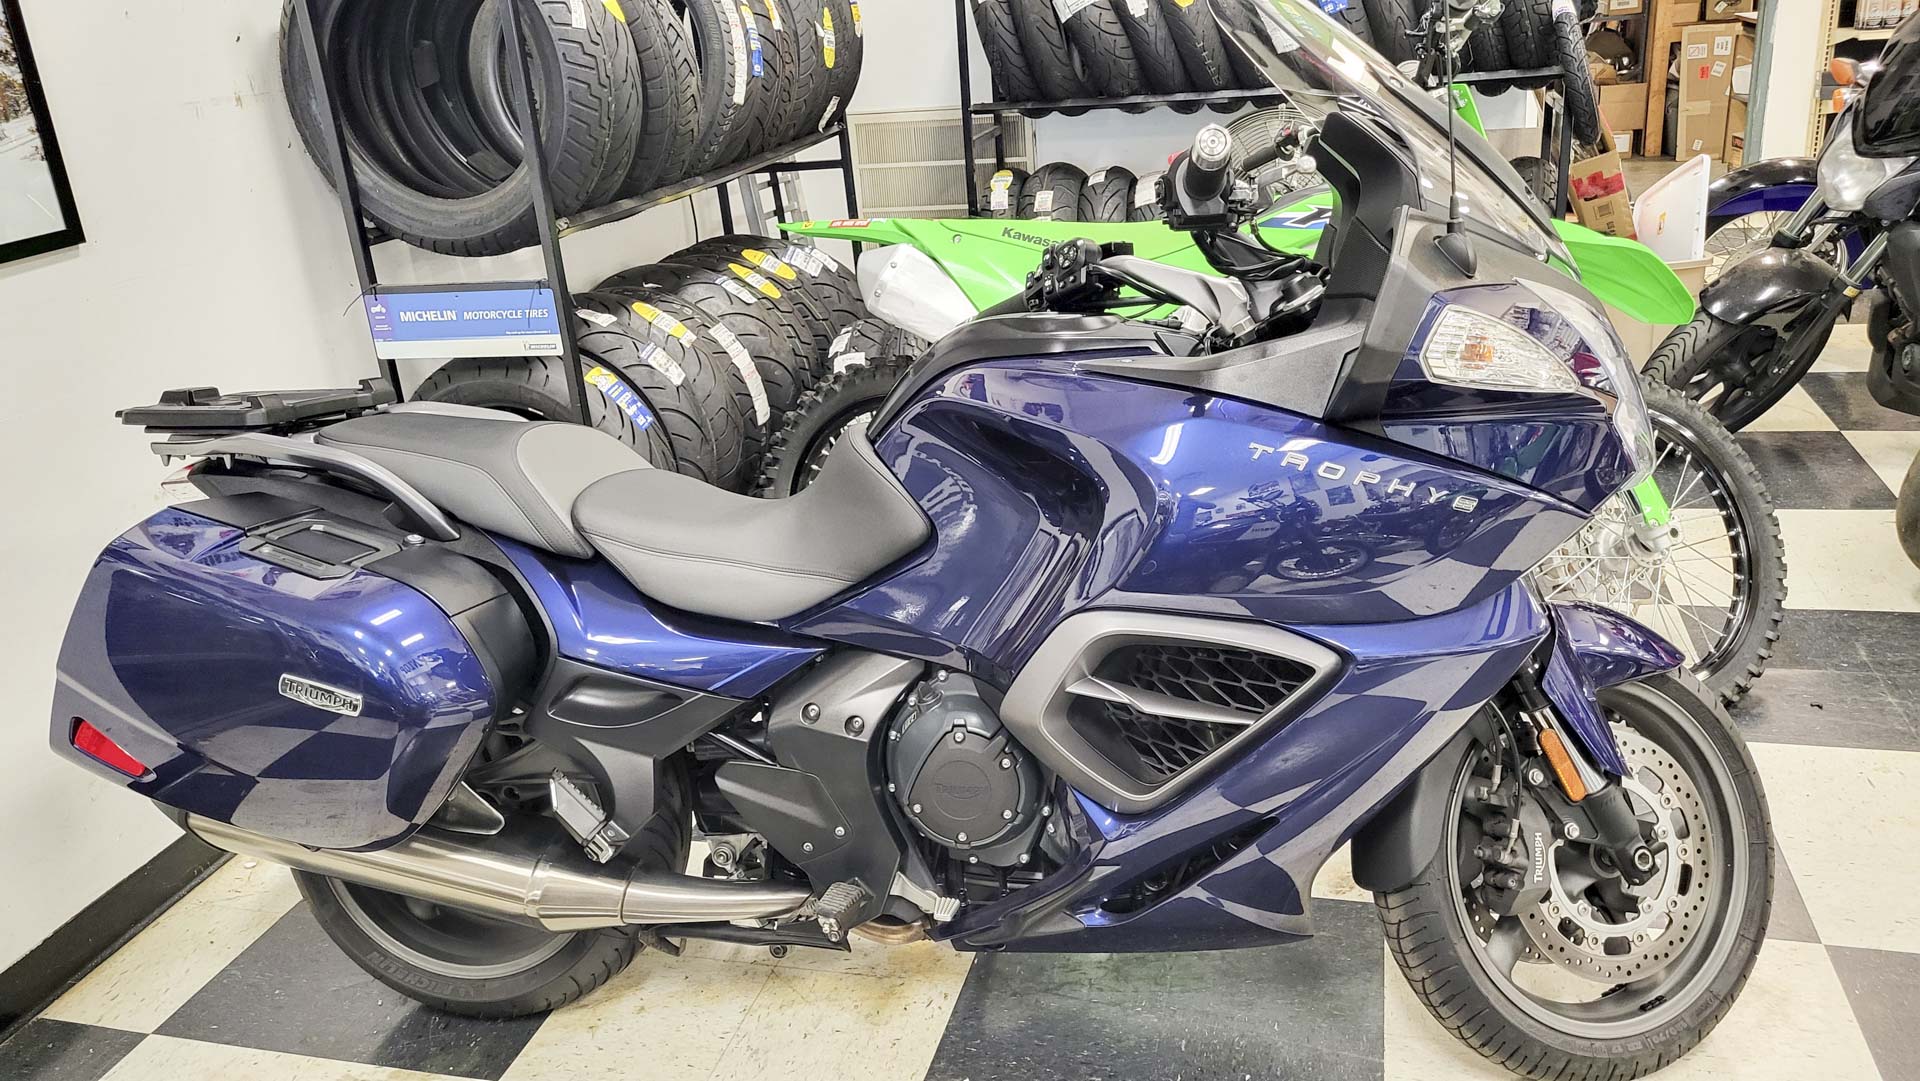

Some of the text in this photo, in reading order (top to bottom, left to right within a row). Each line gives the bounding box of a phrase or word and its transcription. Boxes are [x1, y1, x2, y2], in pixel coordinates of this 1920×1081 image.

[1002, 226, 1064, 247] Kawas
[399, 308, 548, 322] MICHELIN MOTORCYCLE TIRES
[1248, 442, 1449, 505] TROPHY
[284, 678, 354, 711] TRIUMPH
[1533, 832, 1543, 884] TRIUMPH
